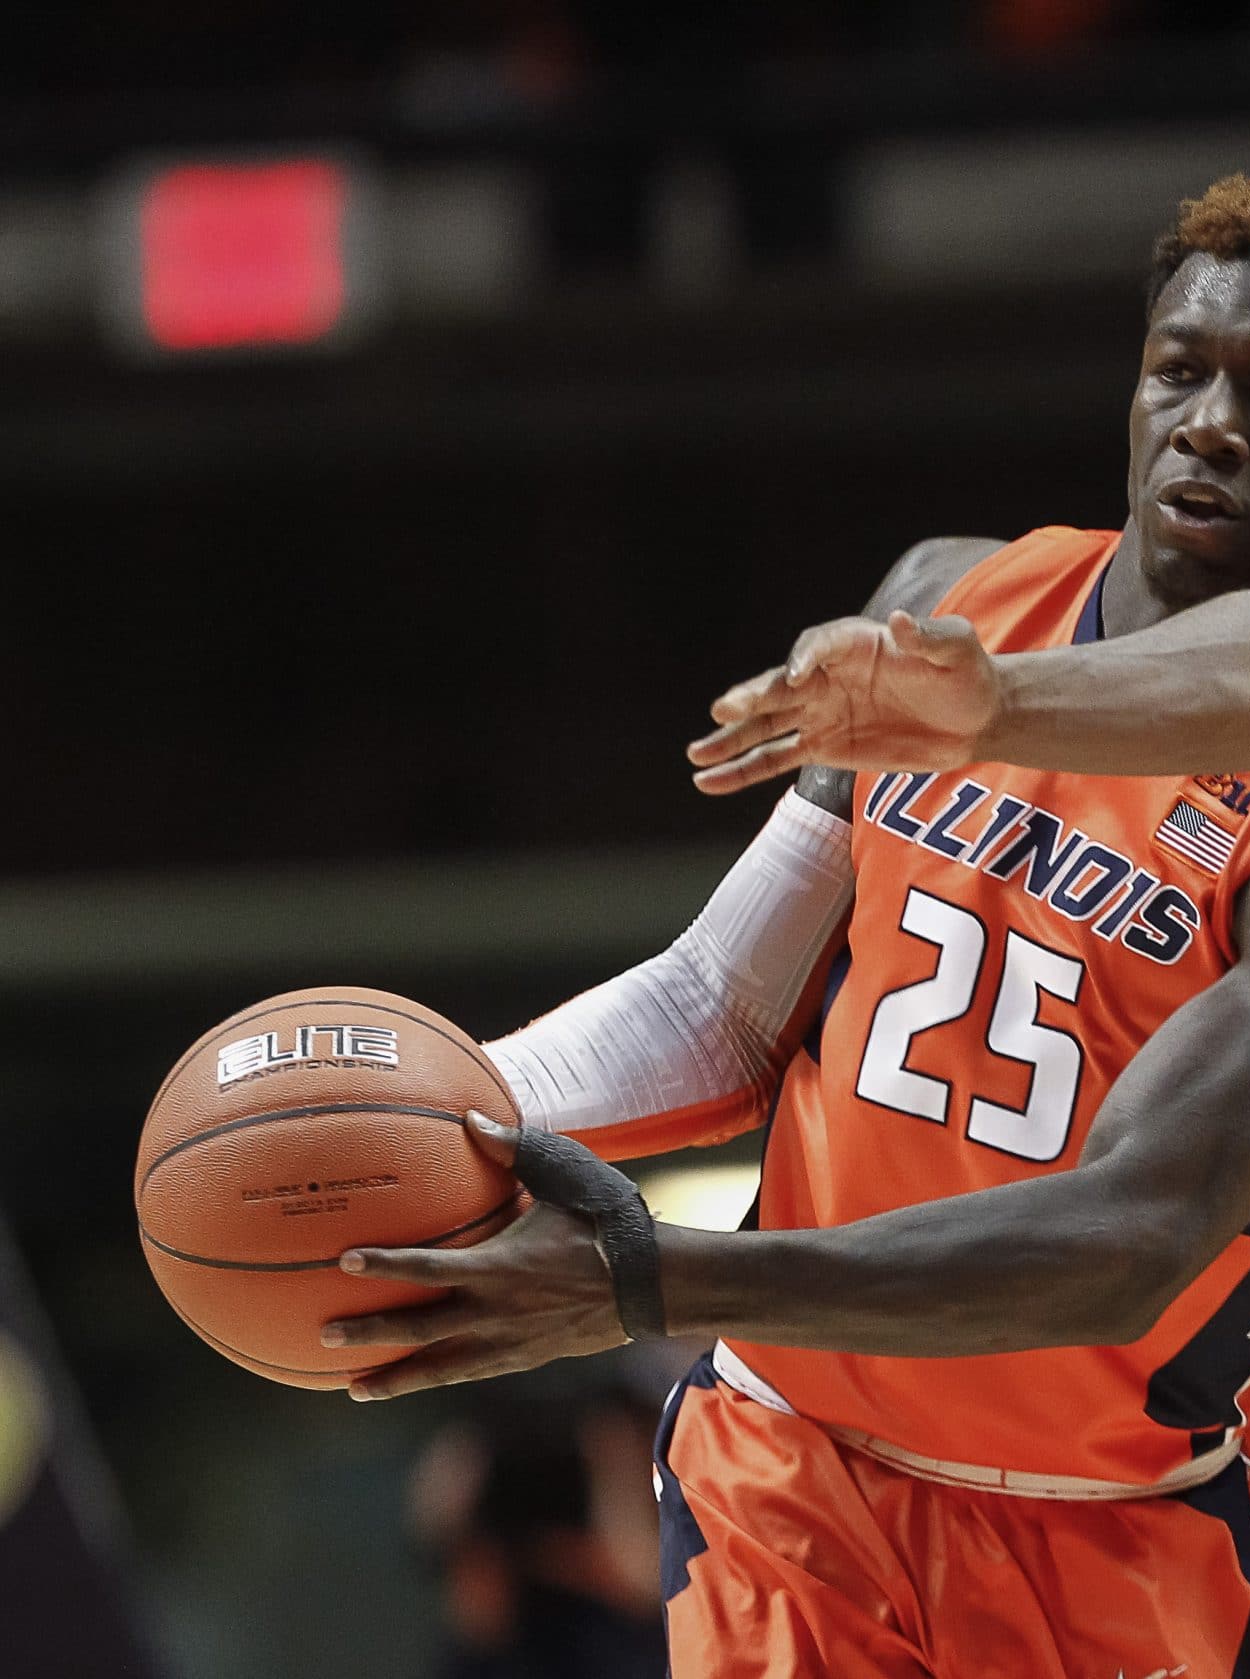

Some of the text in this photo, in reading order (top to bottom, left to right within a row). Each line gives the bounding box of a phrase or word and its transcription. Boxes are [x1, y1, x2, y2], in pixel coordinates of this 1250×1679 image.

[864, 773, 1201, 965] ILLINOIS
[217, 1024, 399, 1085] ELITE
[855, 887, 1084, 1163] 25
